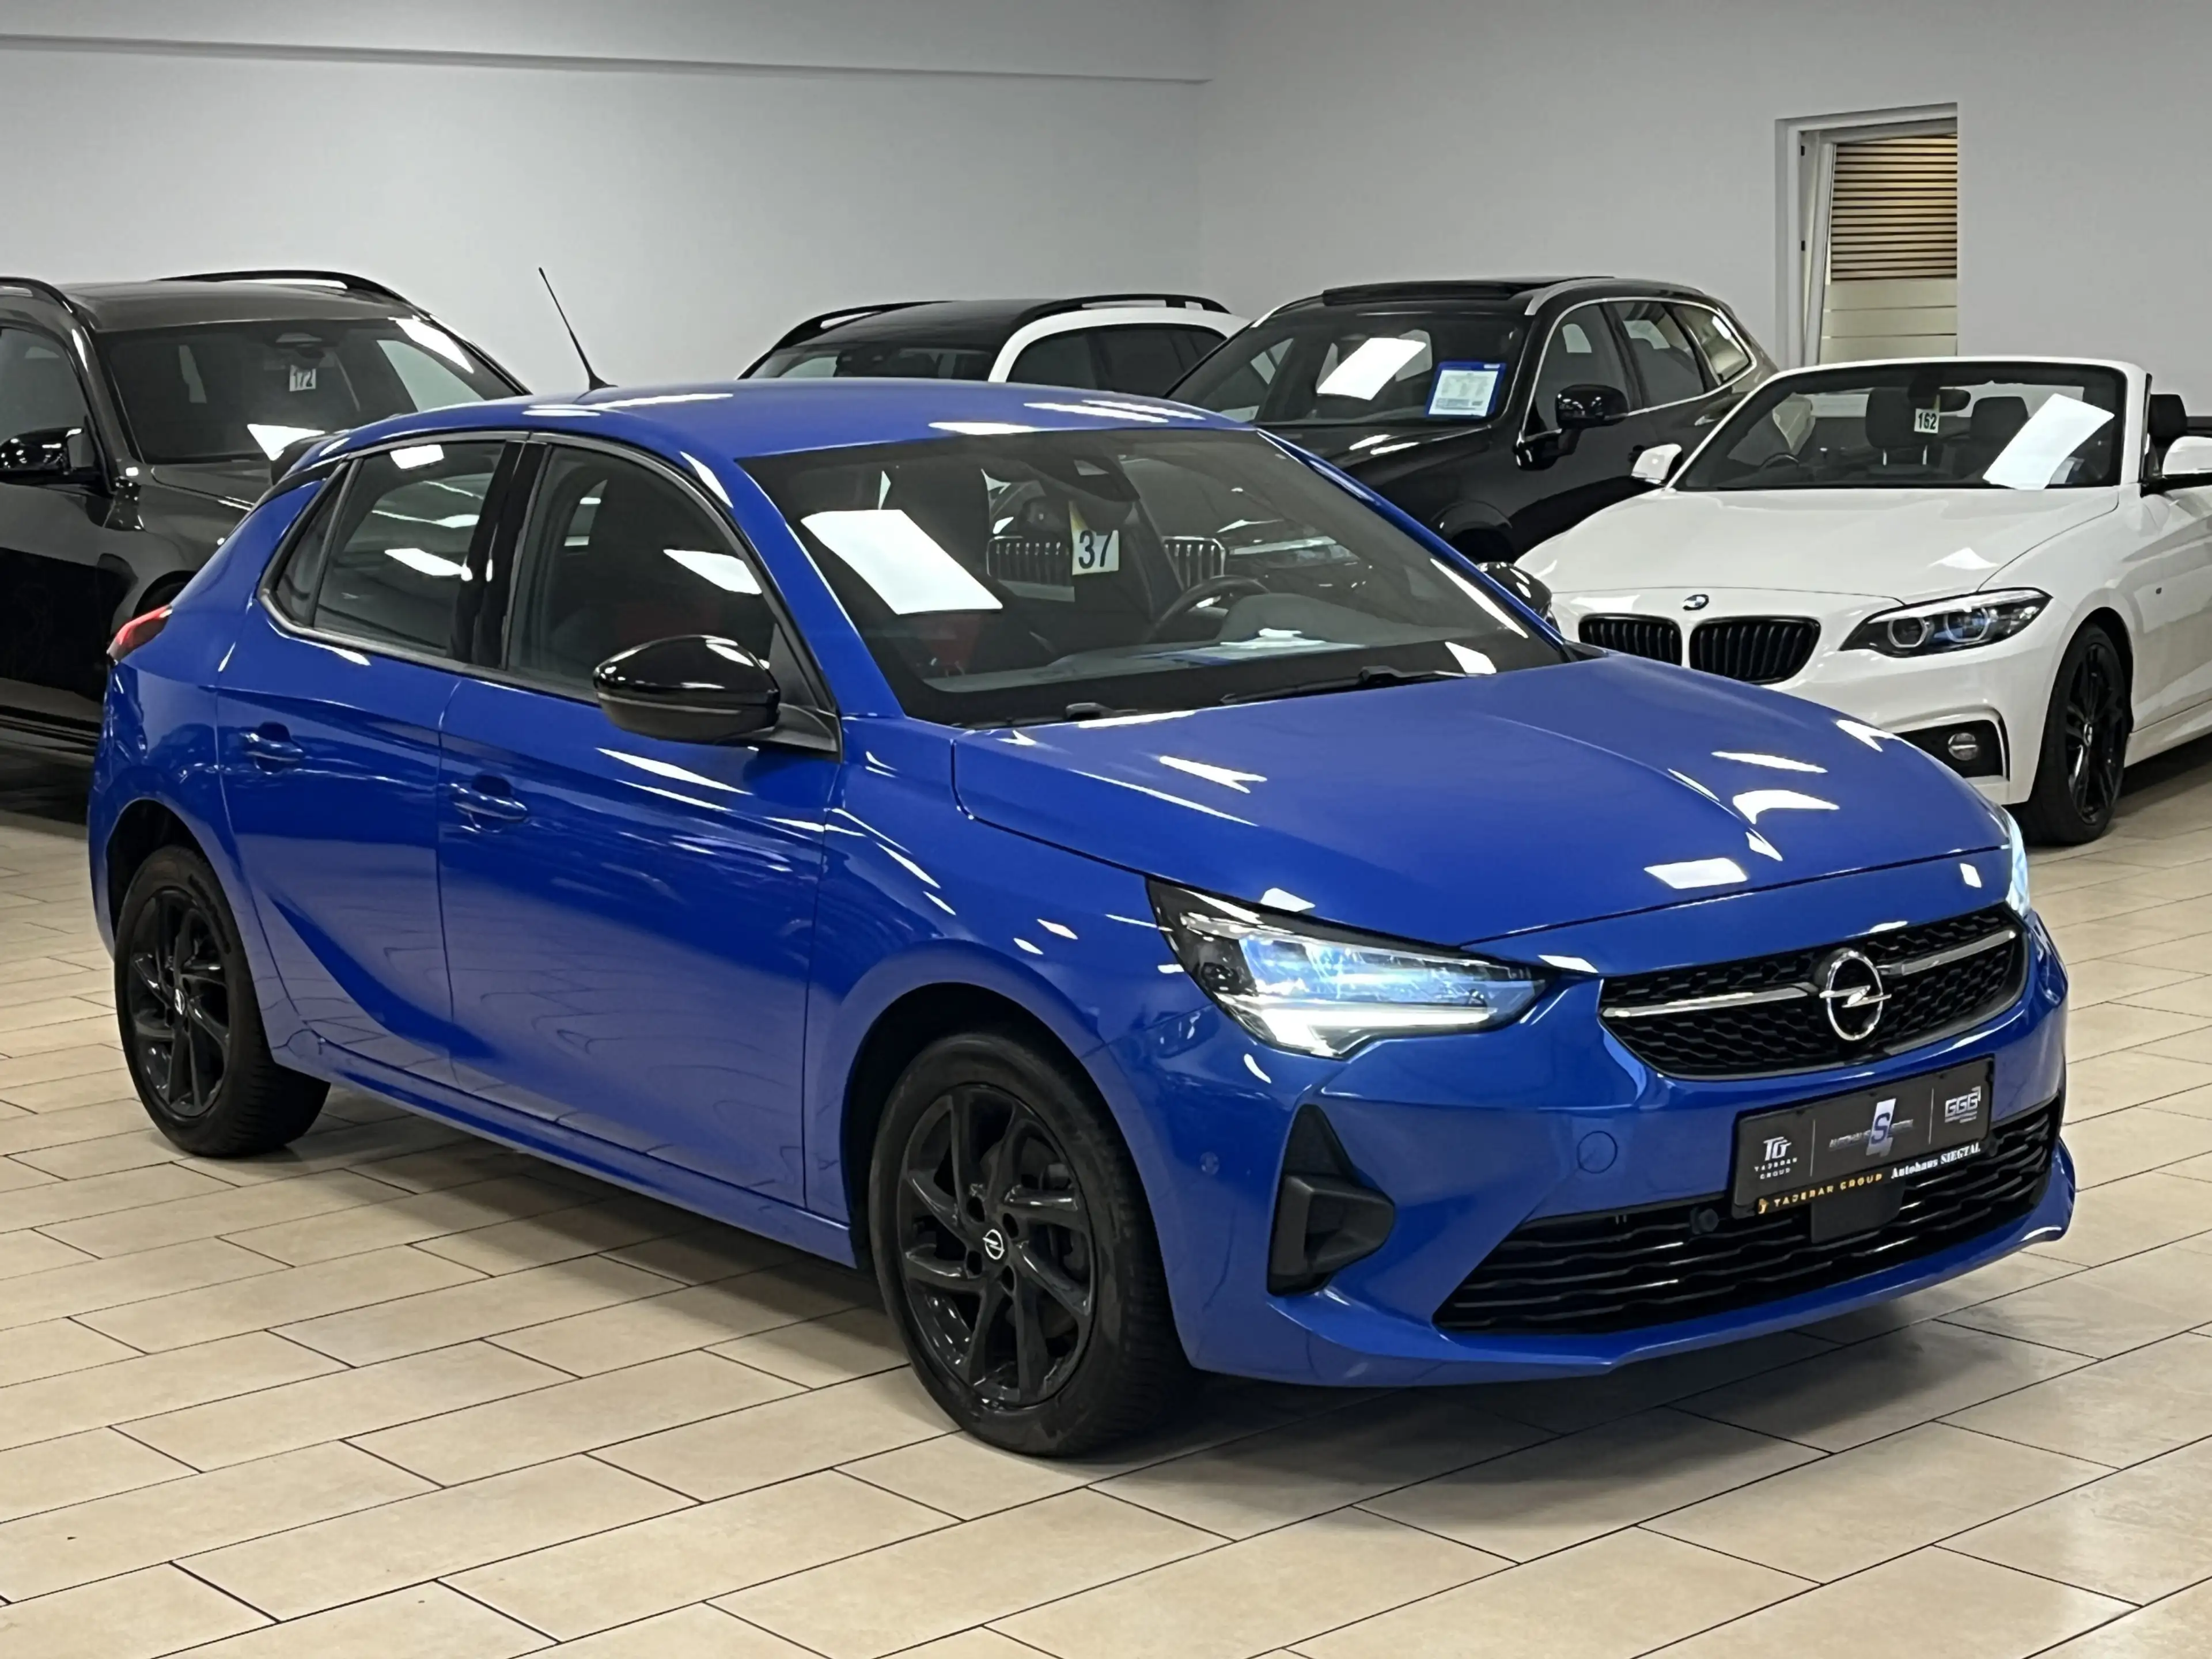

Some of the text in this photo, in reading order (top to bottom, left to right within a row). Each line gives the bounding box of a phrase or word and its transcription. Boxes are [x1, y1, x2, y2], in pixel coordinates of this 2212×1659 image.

[1918, 412, 1937, 430] 162
[1078, 530, 1113, 569] 37
[1891, 1158, 1938, 1179] Autohaus
